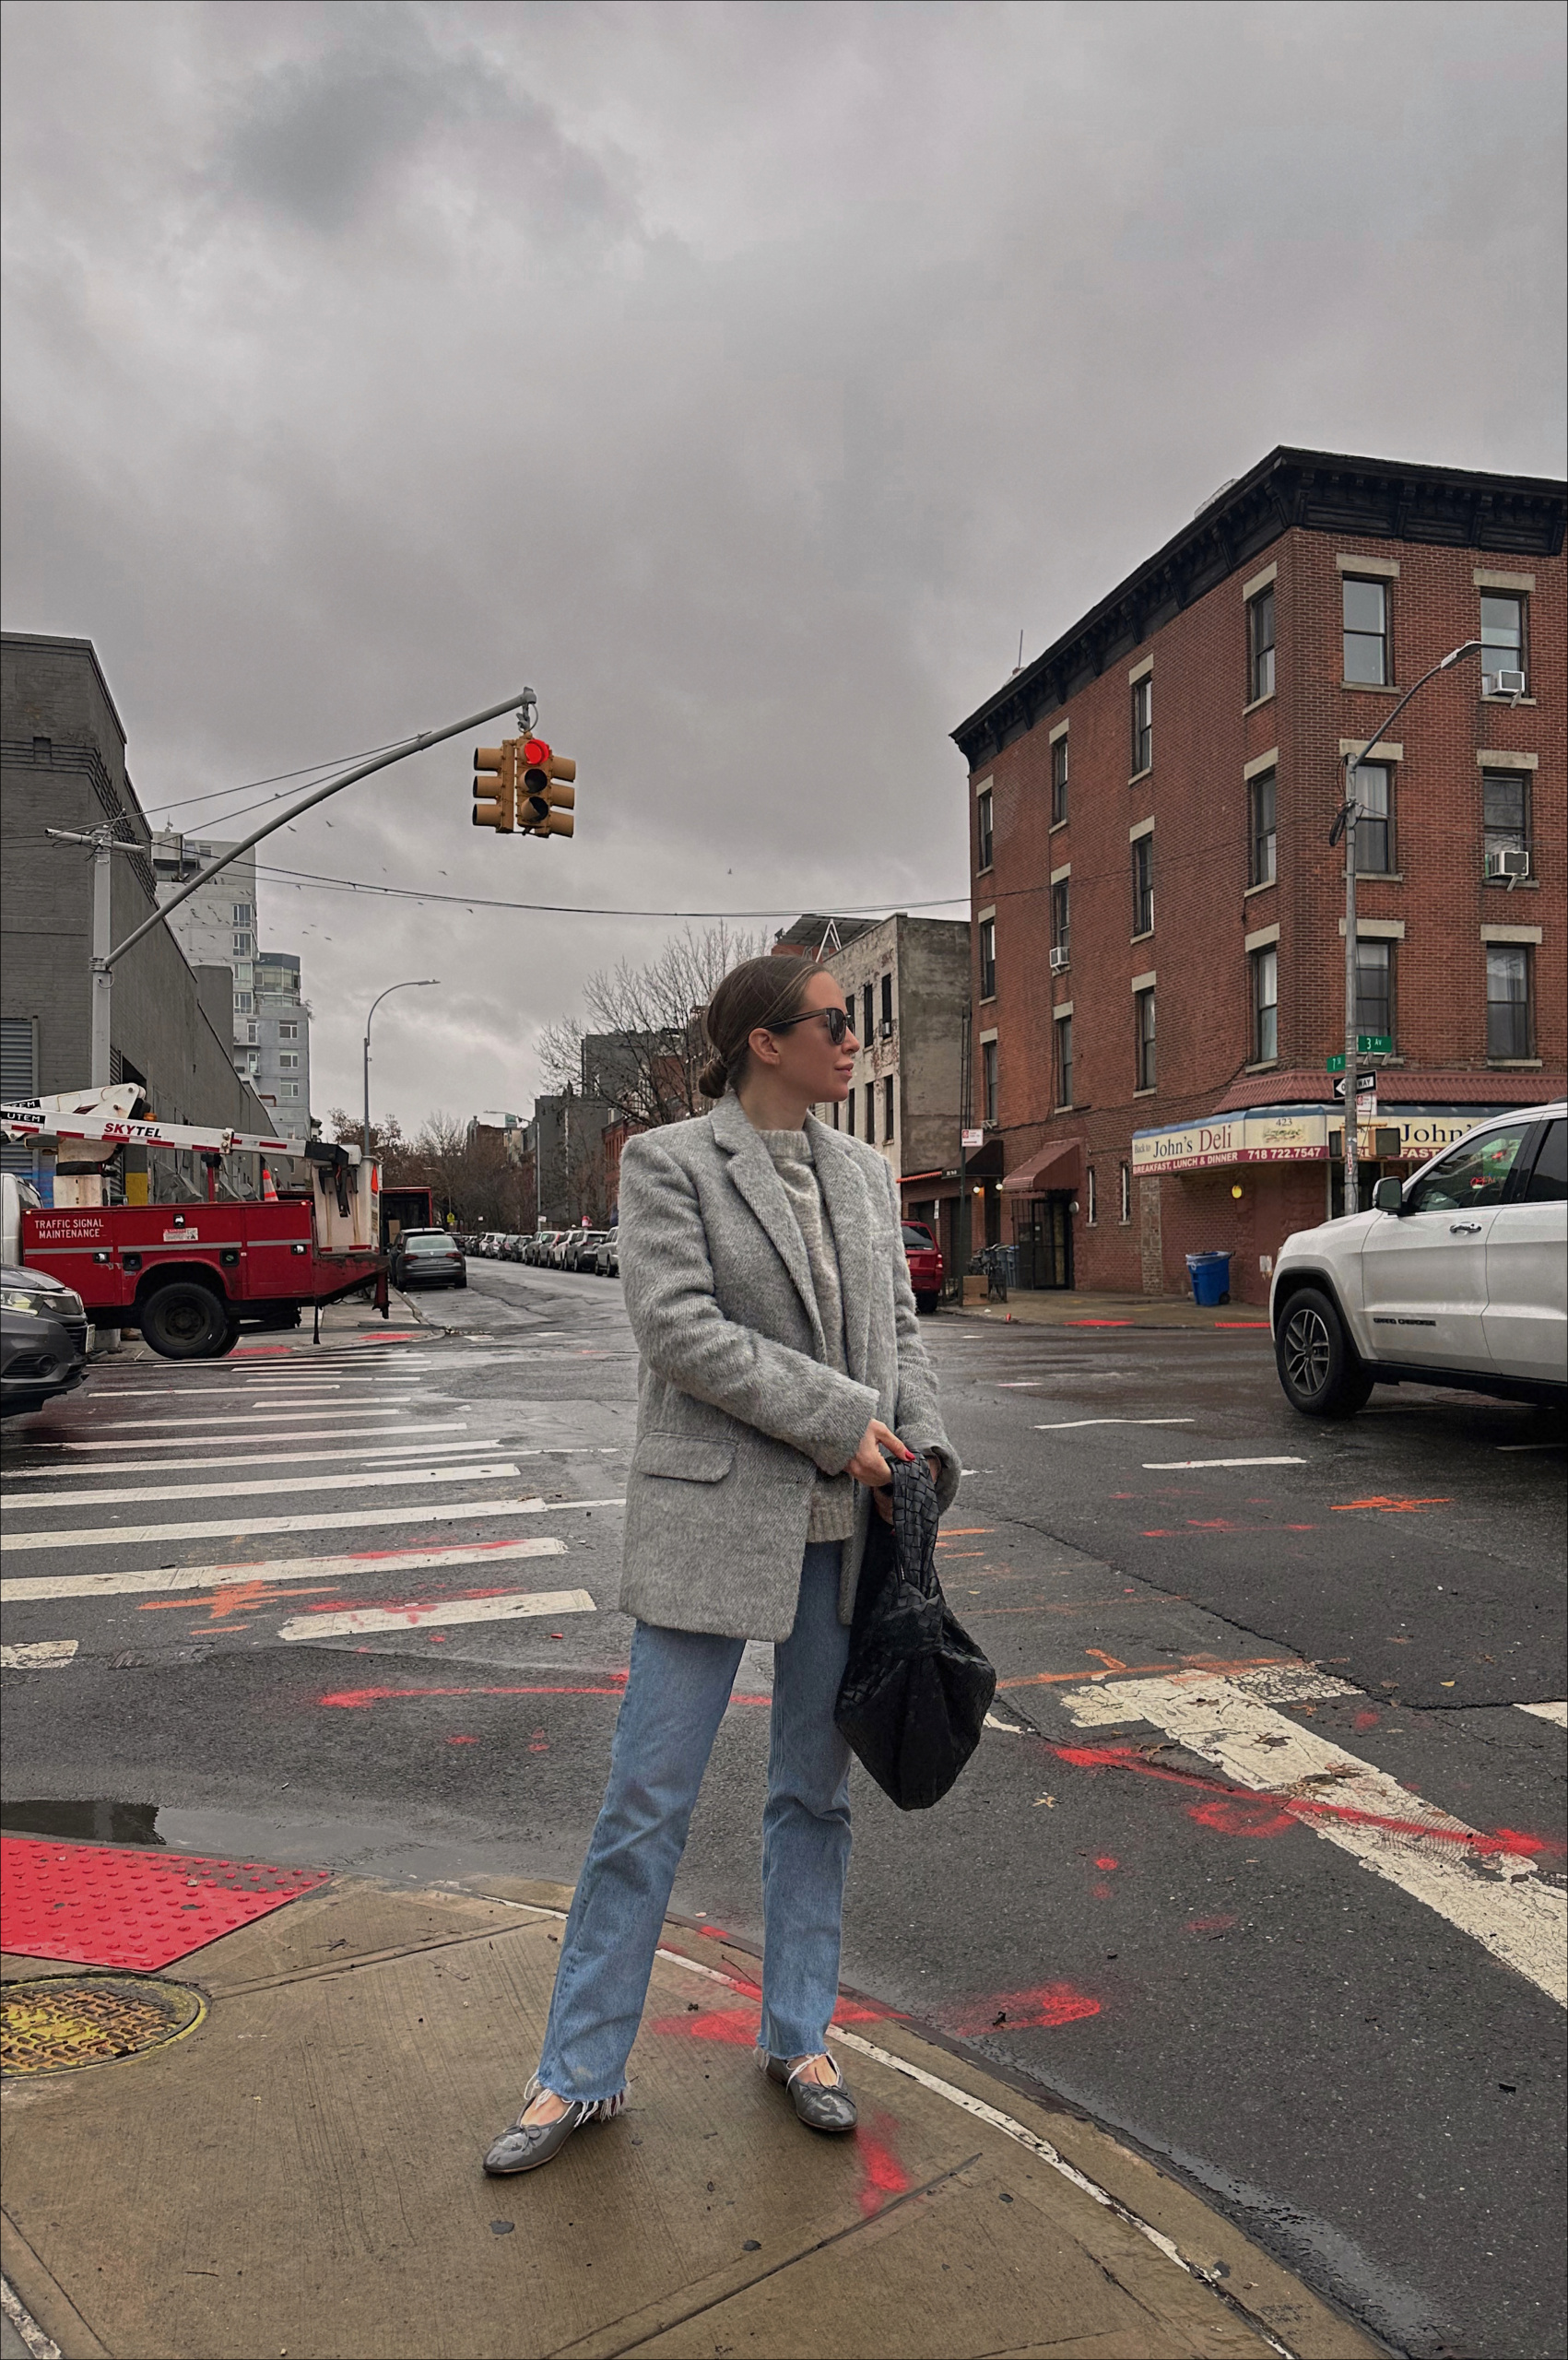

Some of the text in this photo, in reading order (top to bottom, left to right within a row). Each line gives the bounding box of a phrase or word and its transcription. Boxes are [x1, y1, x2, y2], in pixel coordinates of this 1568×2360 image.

[1366, 1037, 1372, 1050] 3
[1357, 1079, 1371, 1088] WAY
[6, 1112, 41, 1123] UTEM
[1275, 1117, 1292, 1127] 423
[103, 1123, 162, 1139] SKYTEL
[1152, 1136, 1193, 1158] John's
[1198, 1125, 1232, 1152] Deli
[1247, 1147, 1321, 1160] 718 722.7547
[1133, 1151, 1238, 1174] BREAKFAST, LUNCH & DINNER
[34, 1218, 104, 1230] TRAFFIC SIGNAL
[39, 1228, 100, 1240] MAINTENANCE
